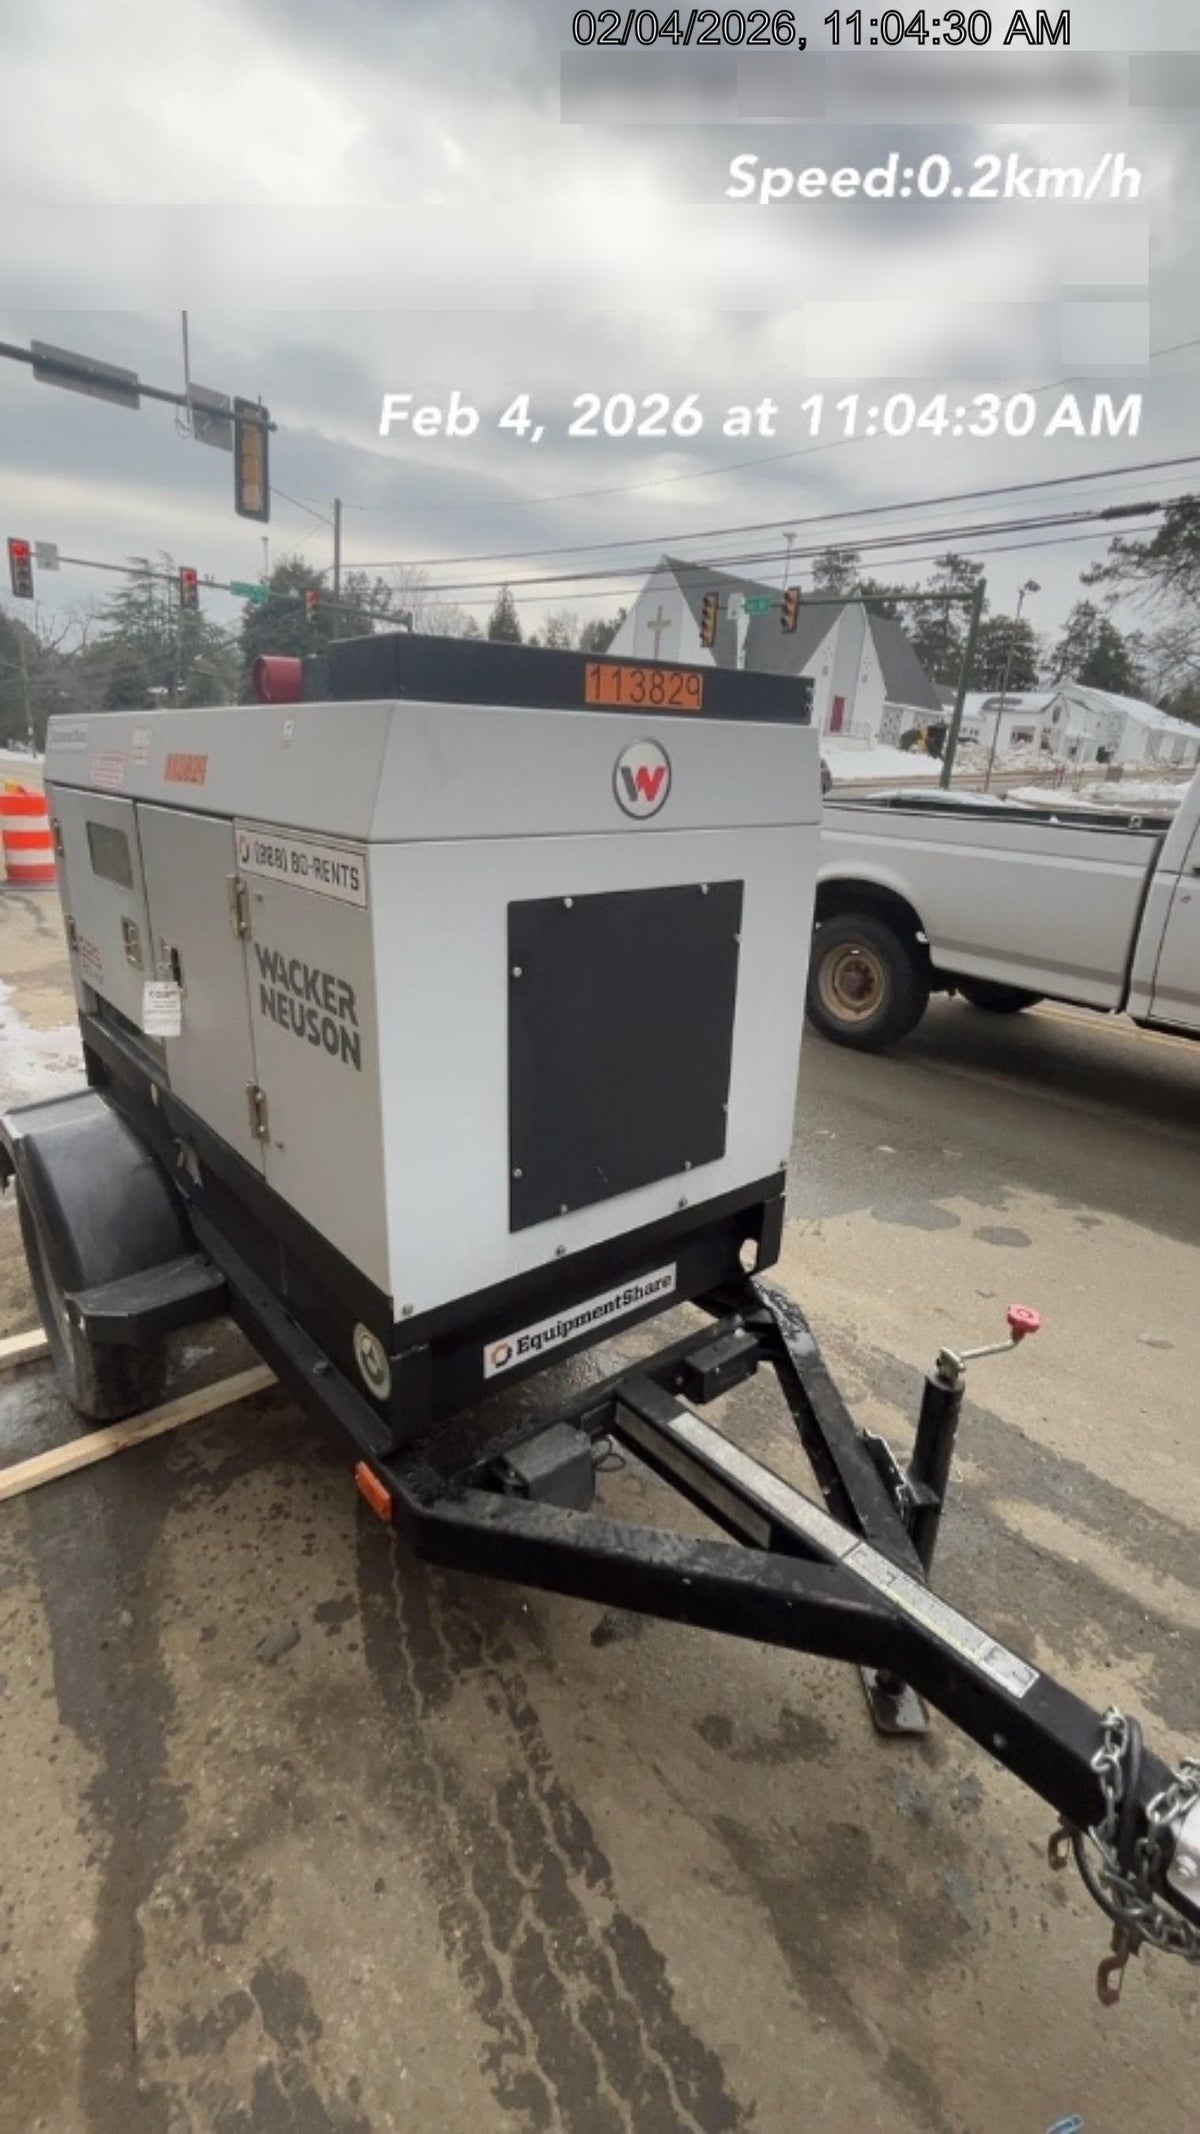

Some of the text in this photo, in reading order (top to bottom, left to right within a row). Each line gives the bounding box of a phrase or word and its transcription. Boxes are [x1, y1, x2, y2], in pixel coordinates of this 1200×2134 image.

[254, 943, 359, 1027] WACKER
[260, 983, 362, 1072] NEUSON
[516, 1274, 672, 1354] EquipmentShare
